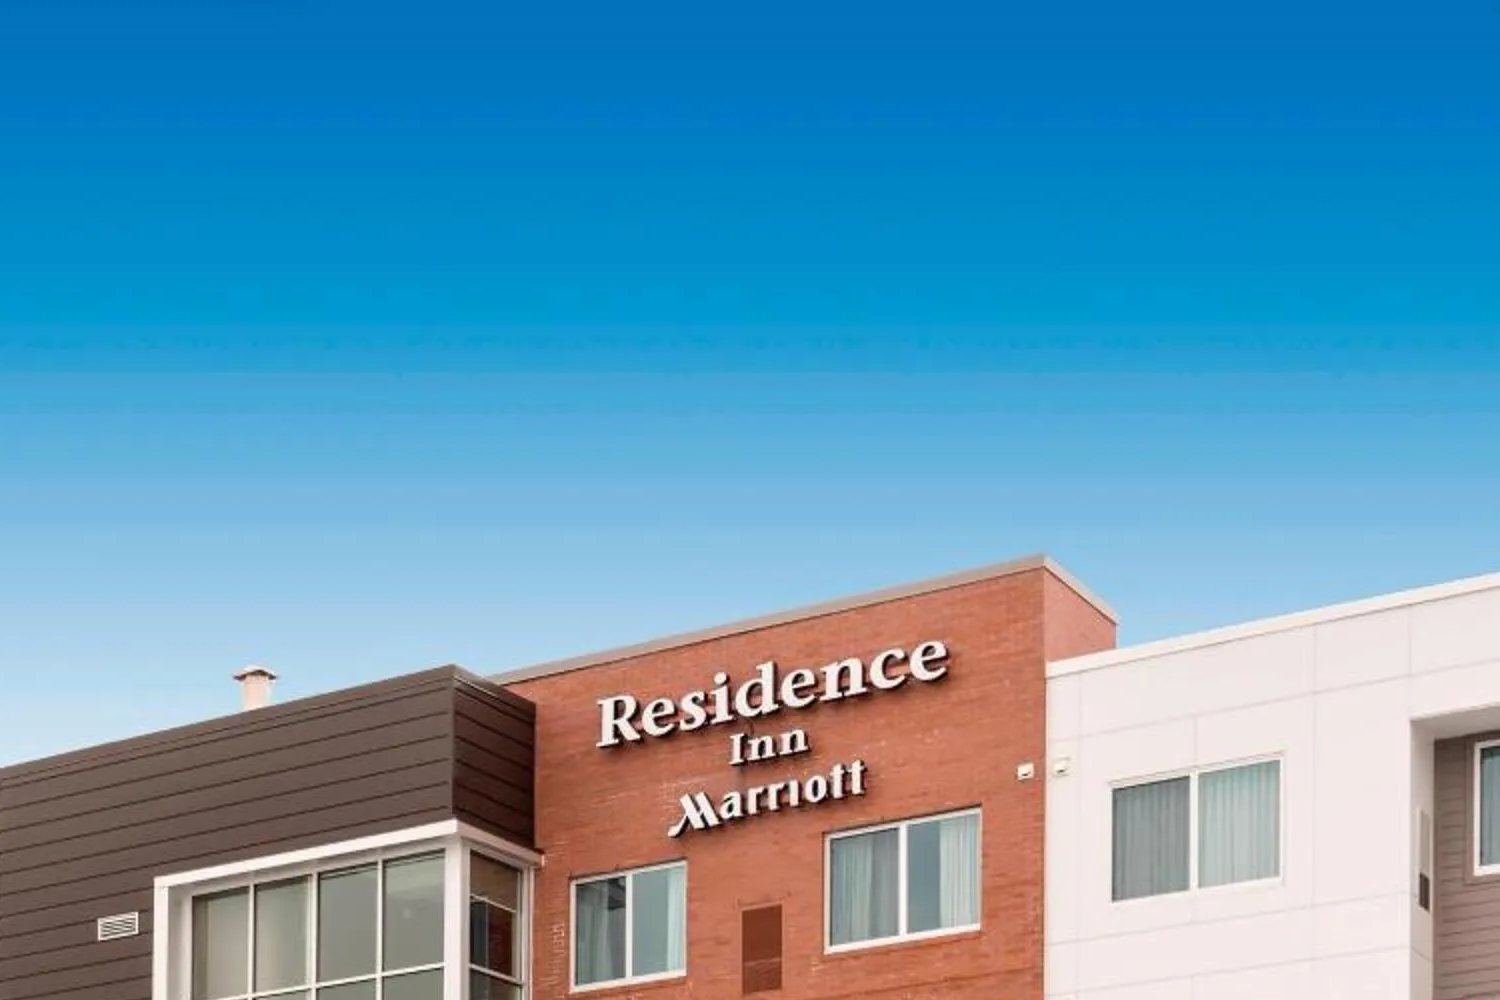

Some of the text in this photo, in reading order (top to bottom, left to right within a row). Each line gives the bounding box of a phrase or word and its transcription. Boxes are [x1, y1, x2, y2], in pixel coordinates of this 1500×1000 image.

[596, 640, 948, 748] Residence
[728, 728, 810, 765] Inn
[668, 759, 866, 838] Marriott
